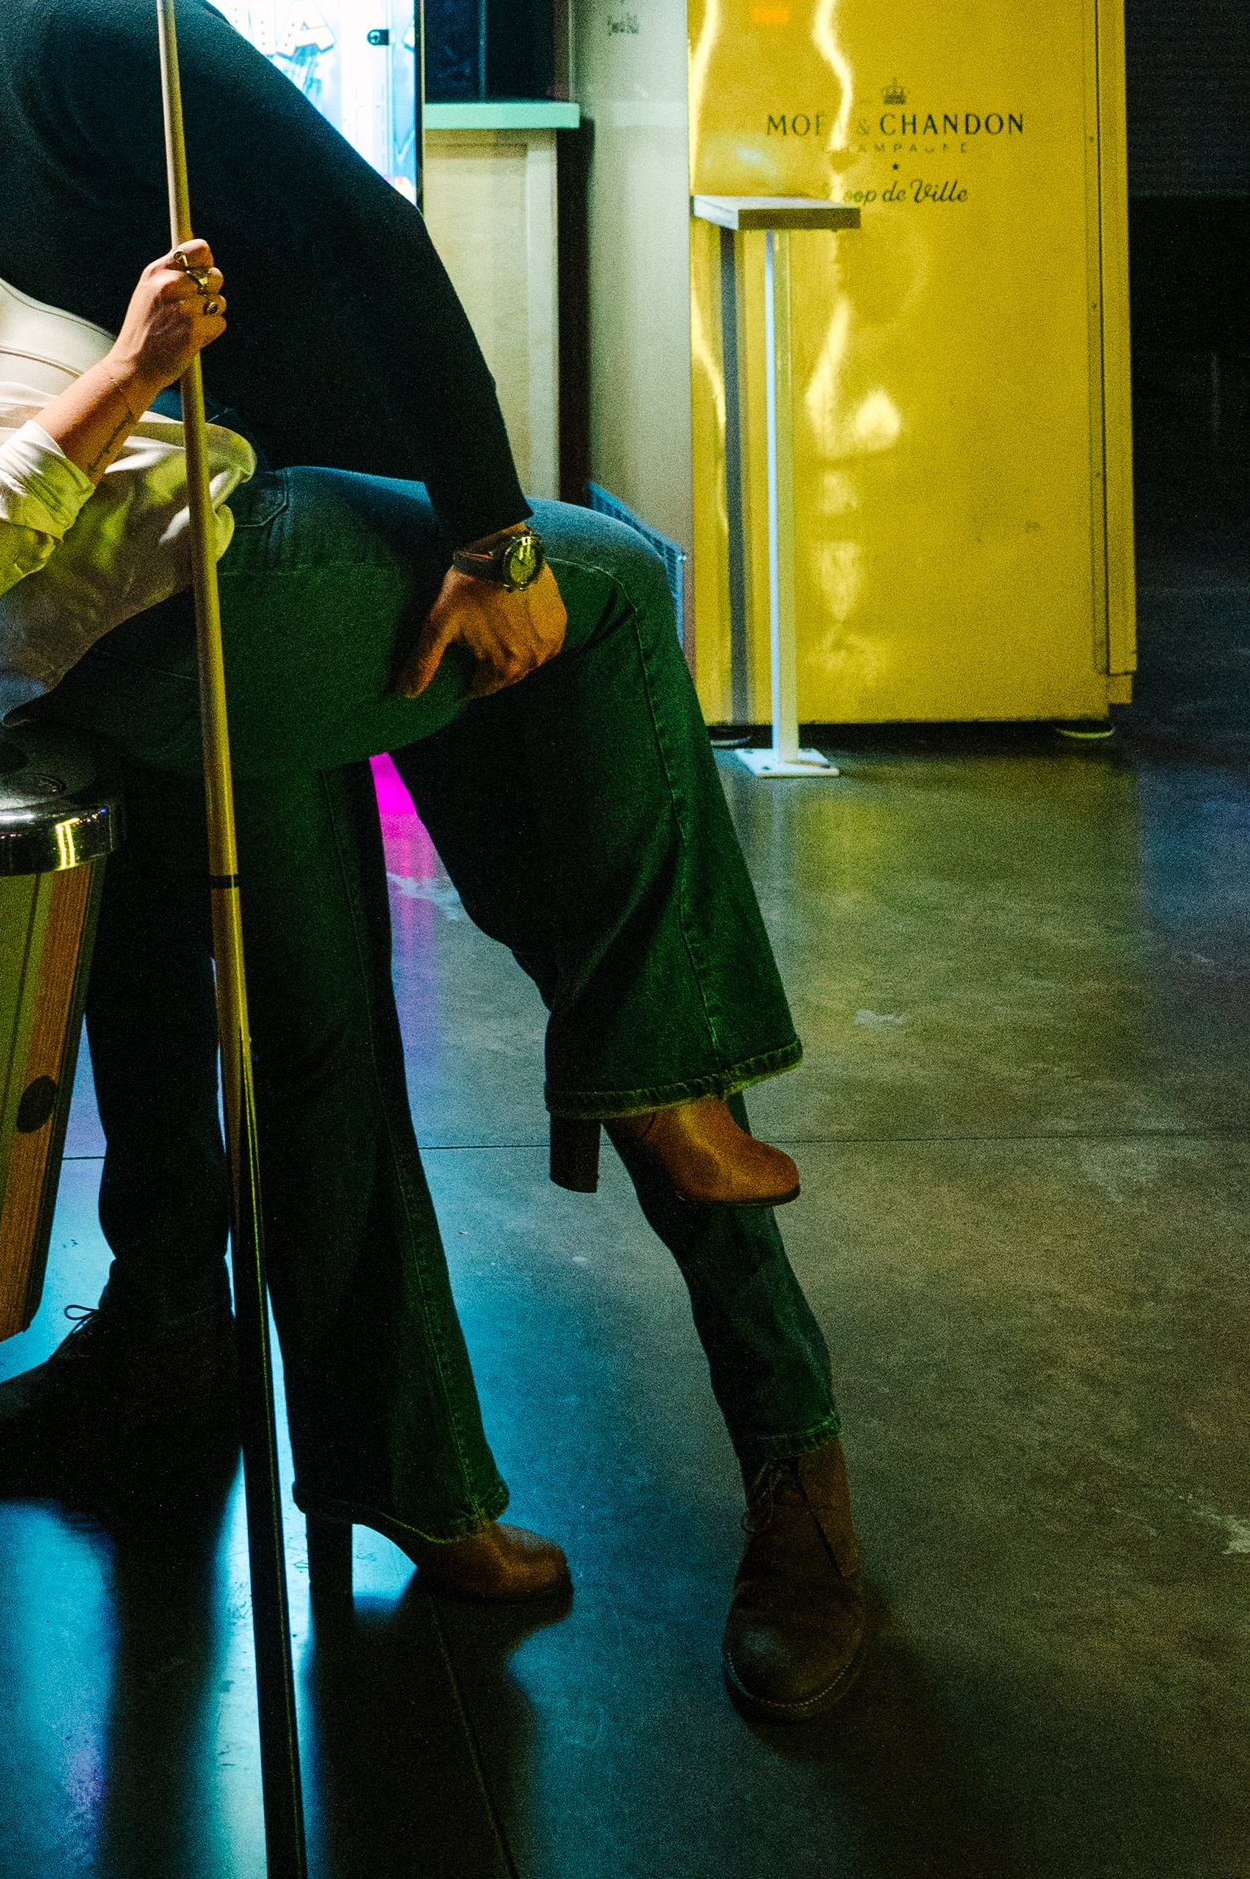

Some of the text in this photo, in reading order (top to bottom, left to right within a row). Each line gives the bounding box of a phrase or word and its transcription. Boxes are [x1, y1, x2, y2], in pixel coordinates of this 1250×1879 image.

[879, 112, 1024, 136] CHANDON
[882, 179, 907, 204] de
[909, 178, 968, 204] Ville
